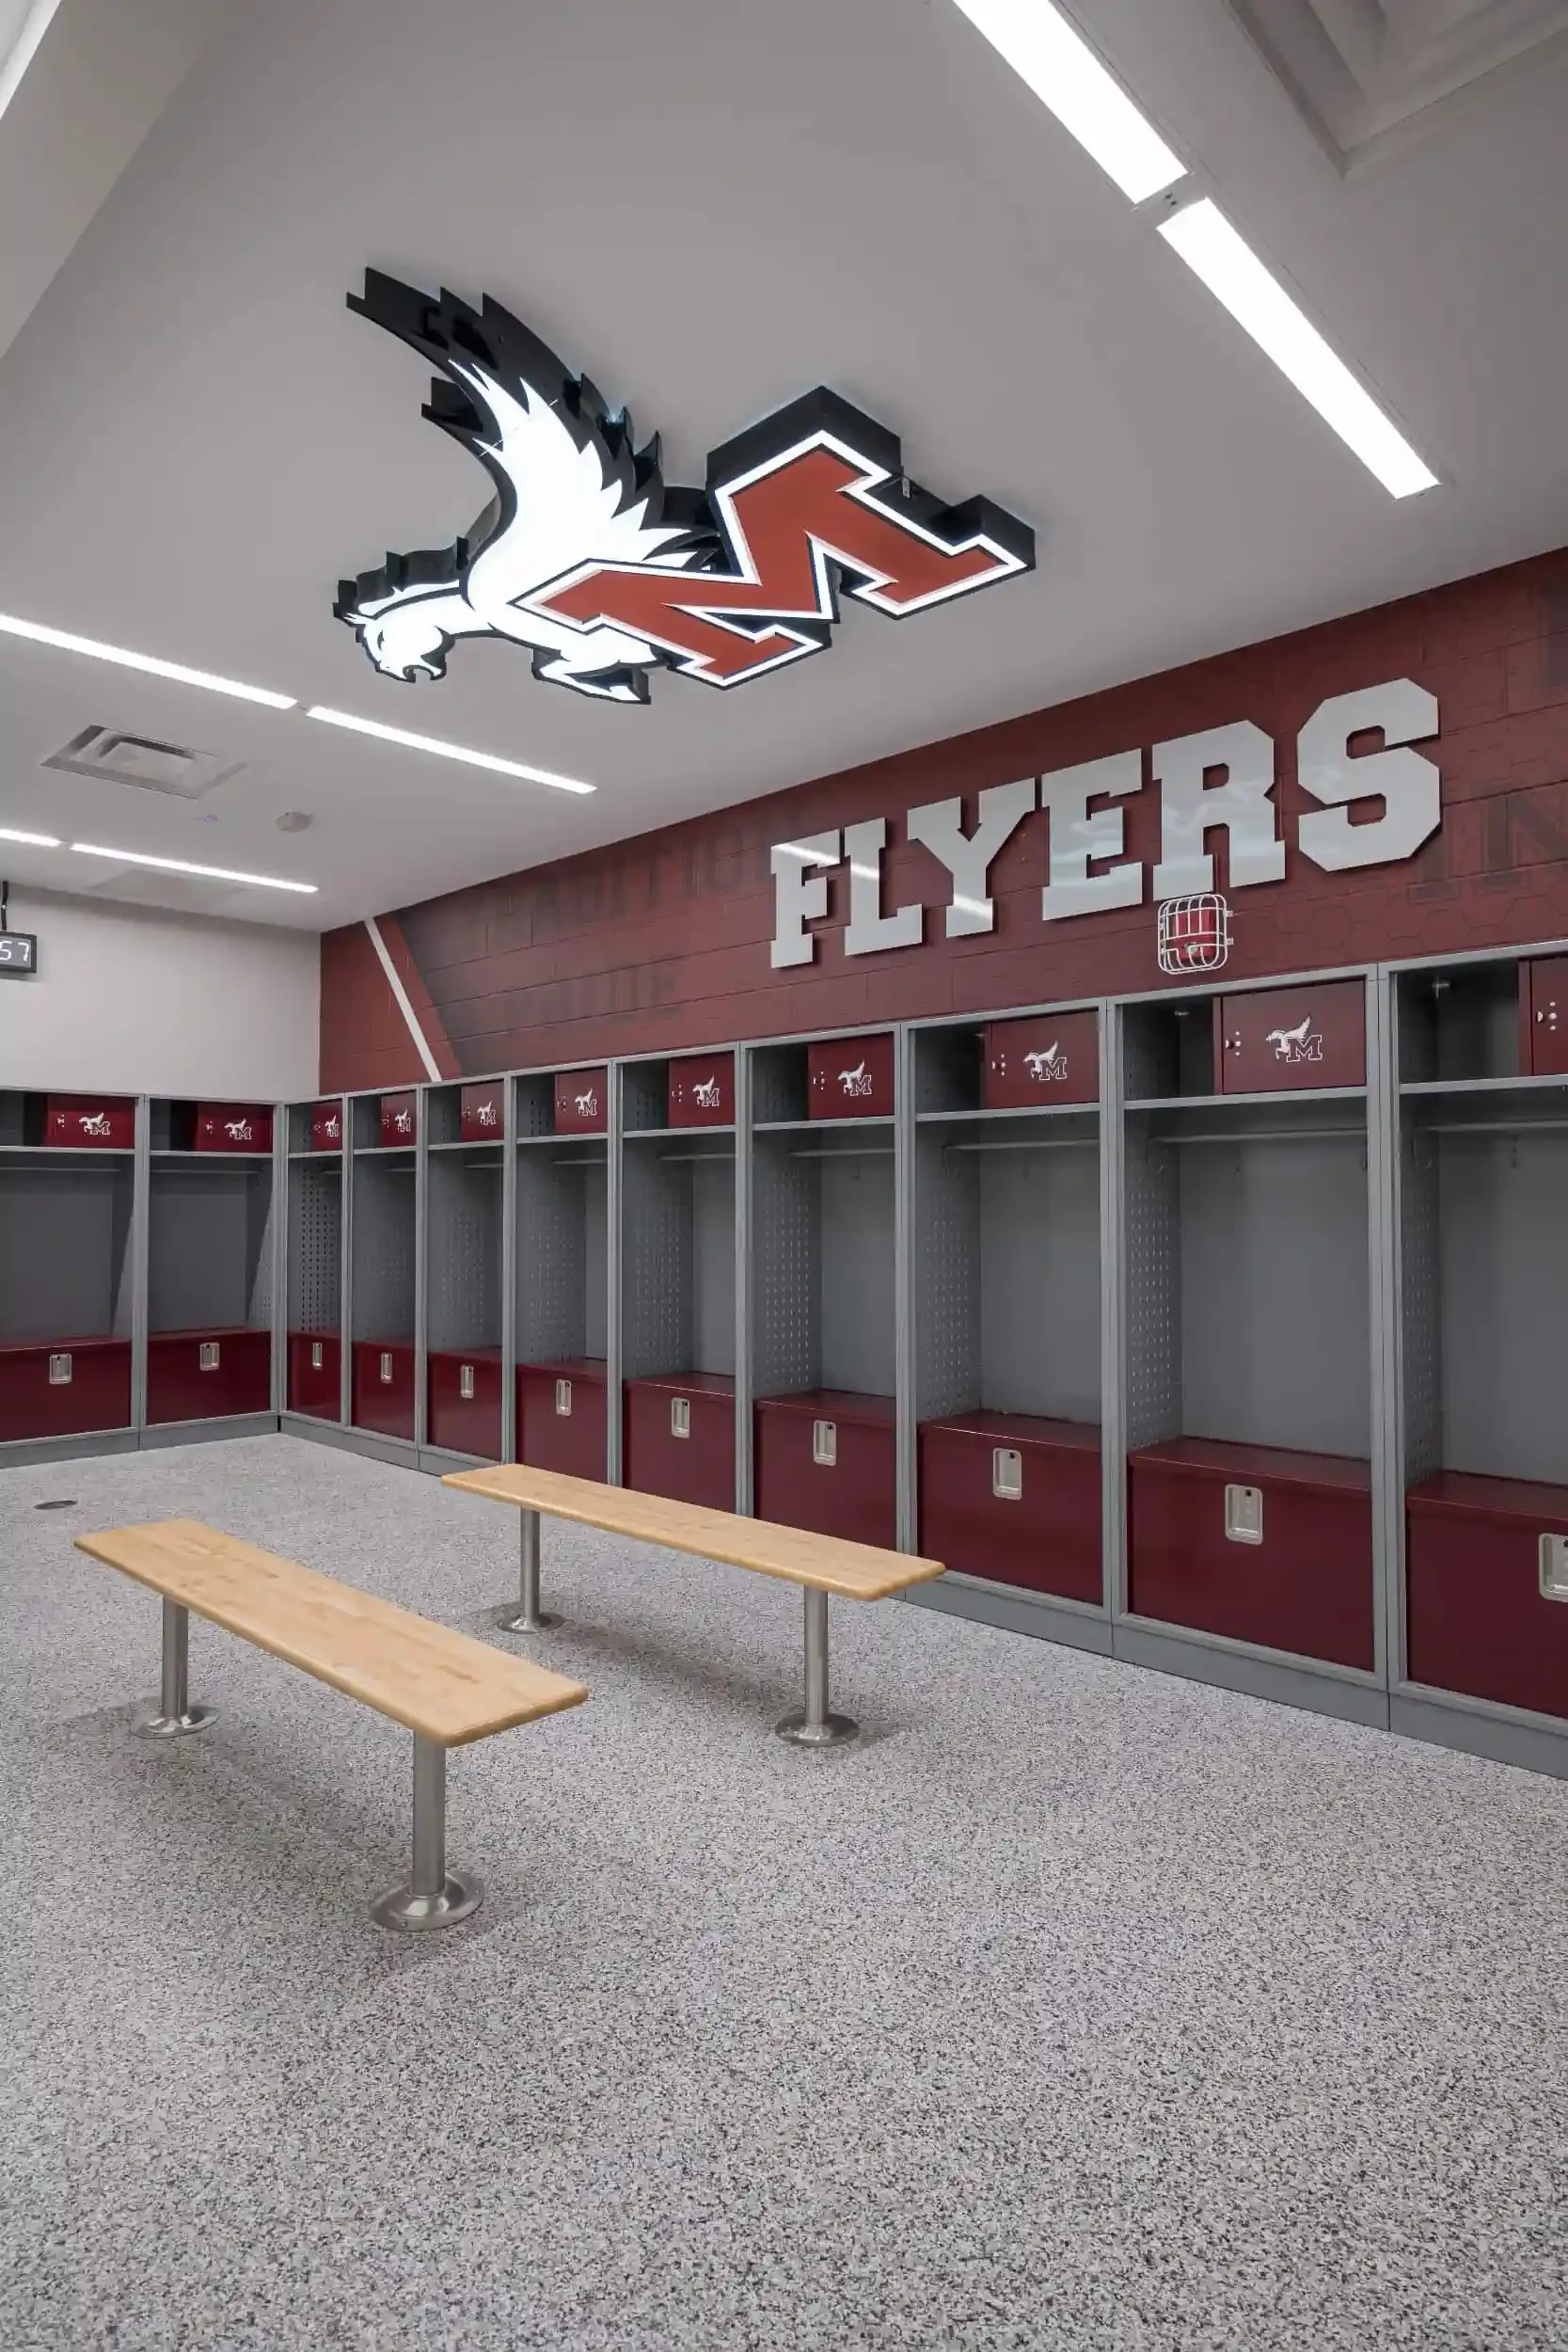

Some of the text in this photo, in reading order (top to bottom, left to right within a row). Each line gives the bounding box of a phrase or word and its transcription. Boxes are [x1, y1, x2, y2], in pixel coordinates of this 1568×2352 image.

[770, 677, 1441, 969] FLYERS
[1286, 1034, 1323, 1063] M
[1038, 1057, 1068, 1081] M
[849, 1074, 872, 1097] M
